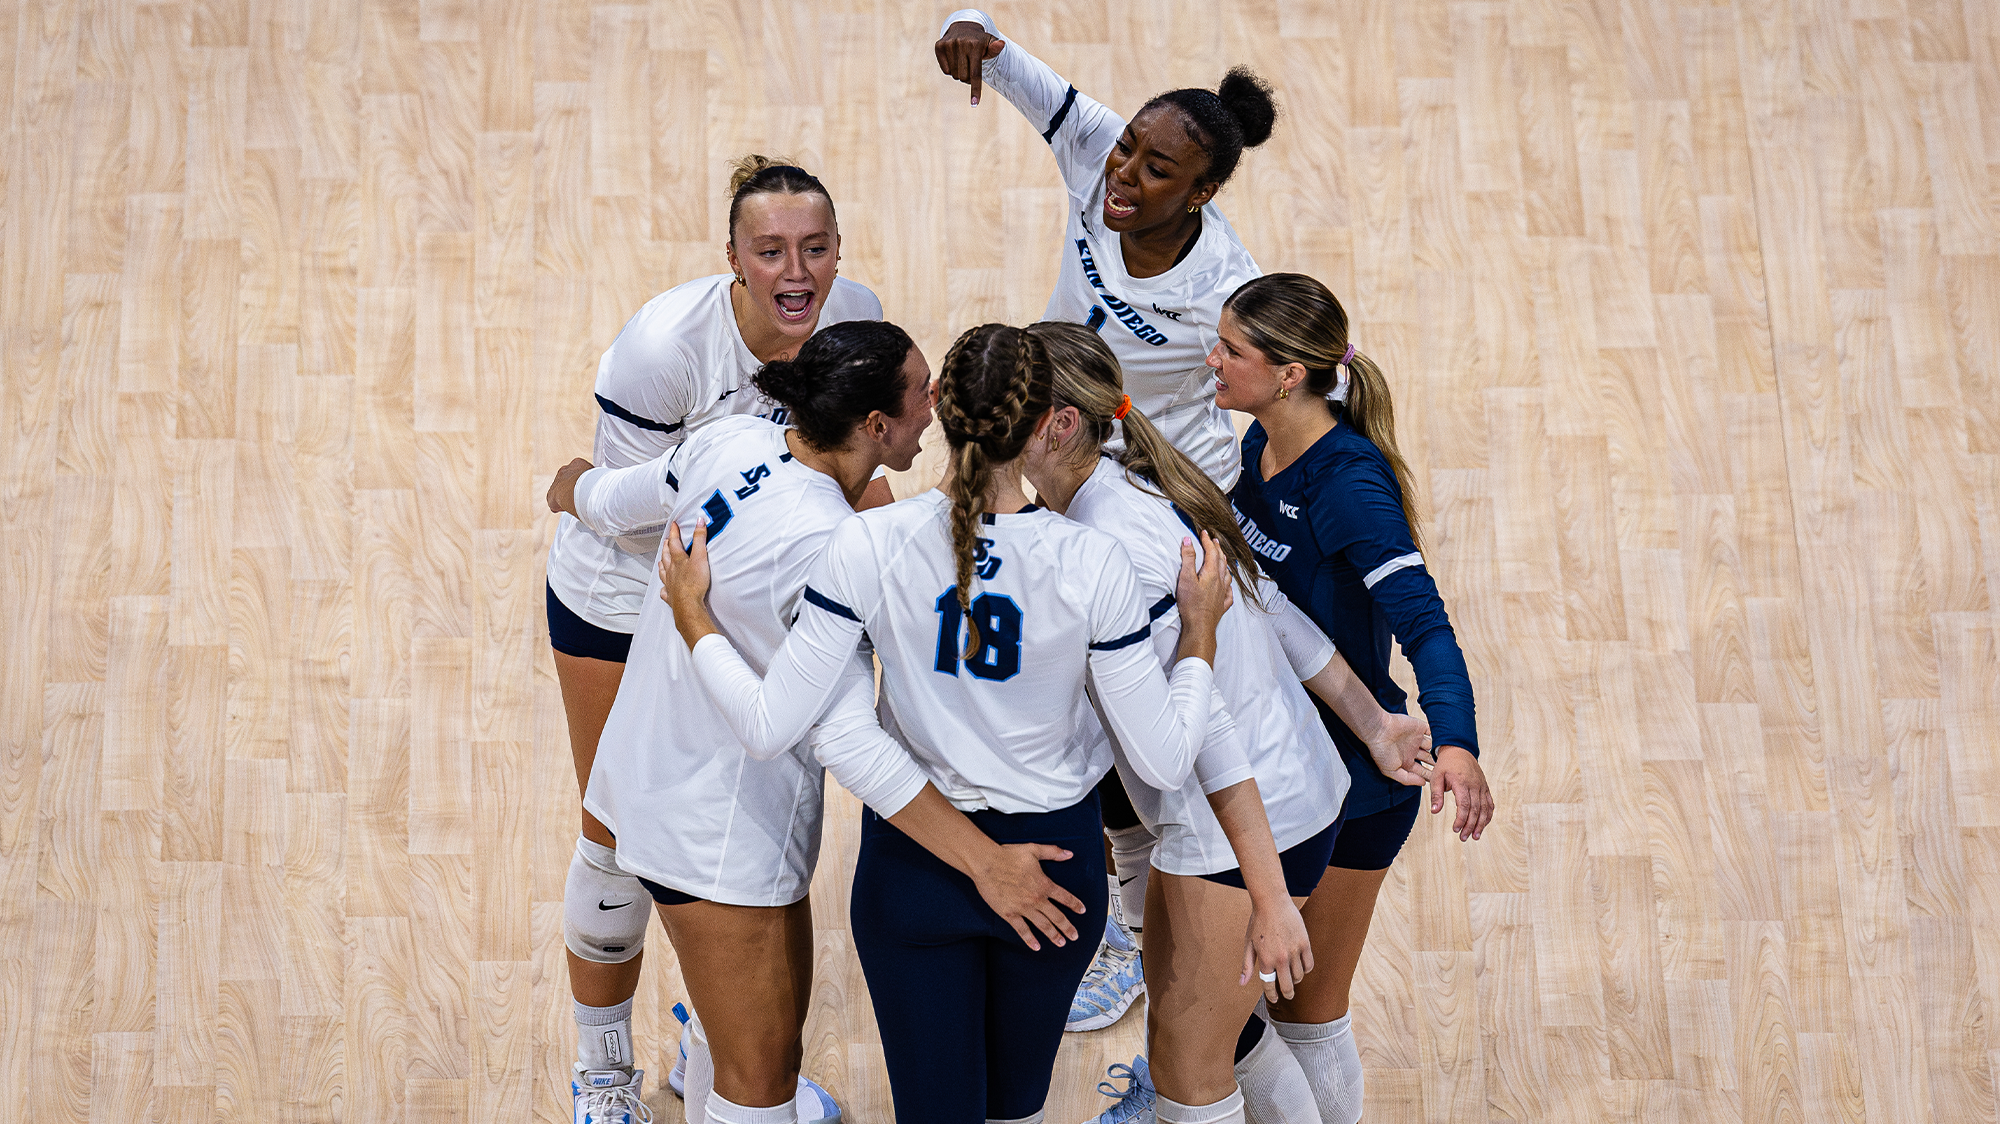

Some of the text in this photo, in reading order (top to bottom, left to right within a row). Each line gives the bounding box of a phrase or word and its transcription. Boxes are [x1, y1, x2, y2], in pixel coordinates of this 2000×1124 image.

[1099, 294, 1169, 346] DIEGO
[1152, 302, 1182, 322] WCC
[1279, 499, 1300, 520] WCC
[1241, 517, 1292, 562] DIEGO
[934, 584, 1024, 682] 18
[593, 1077, 612, 1085] NIKE
